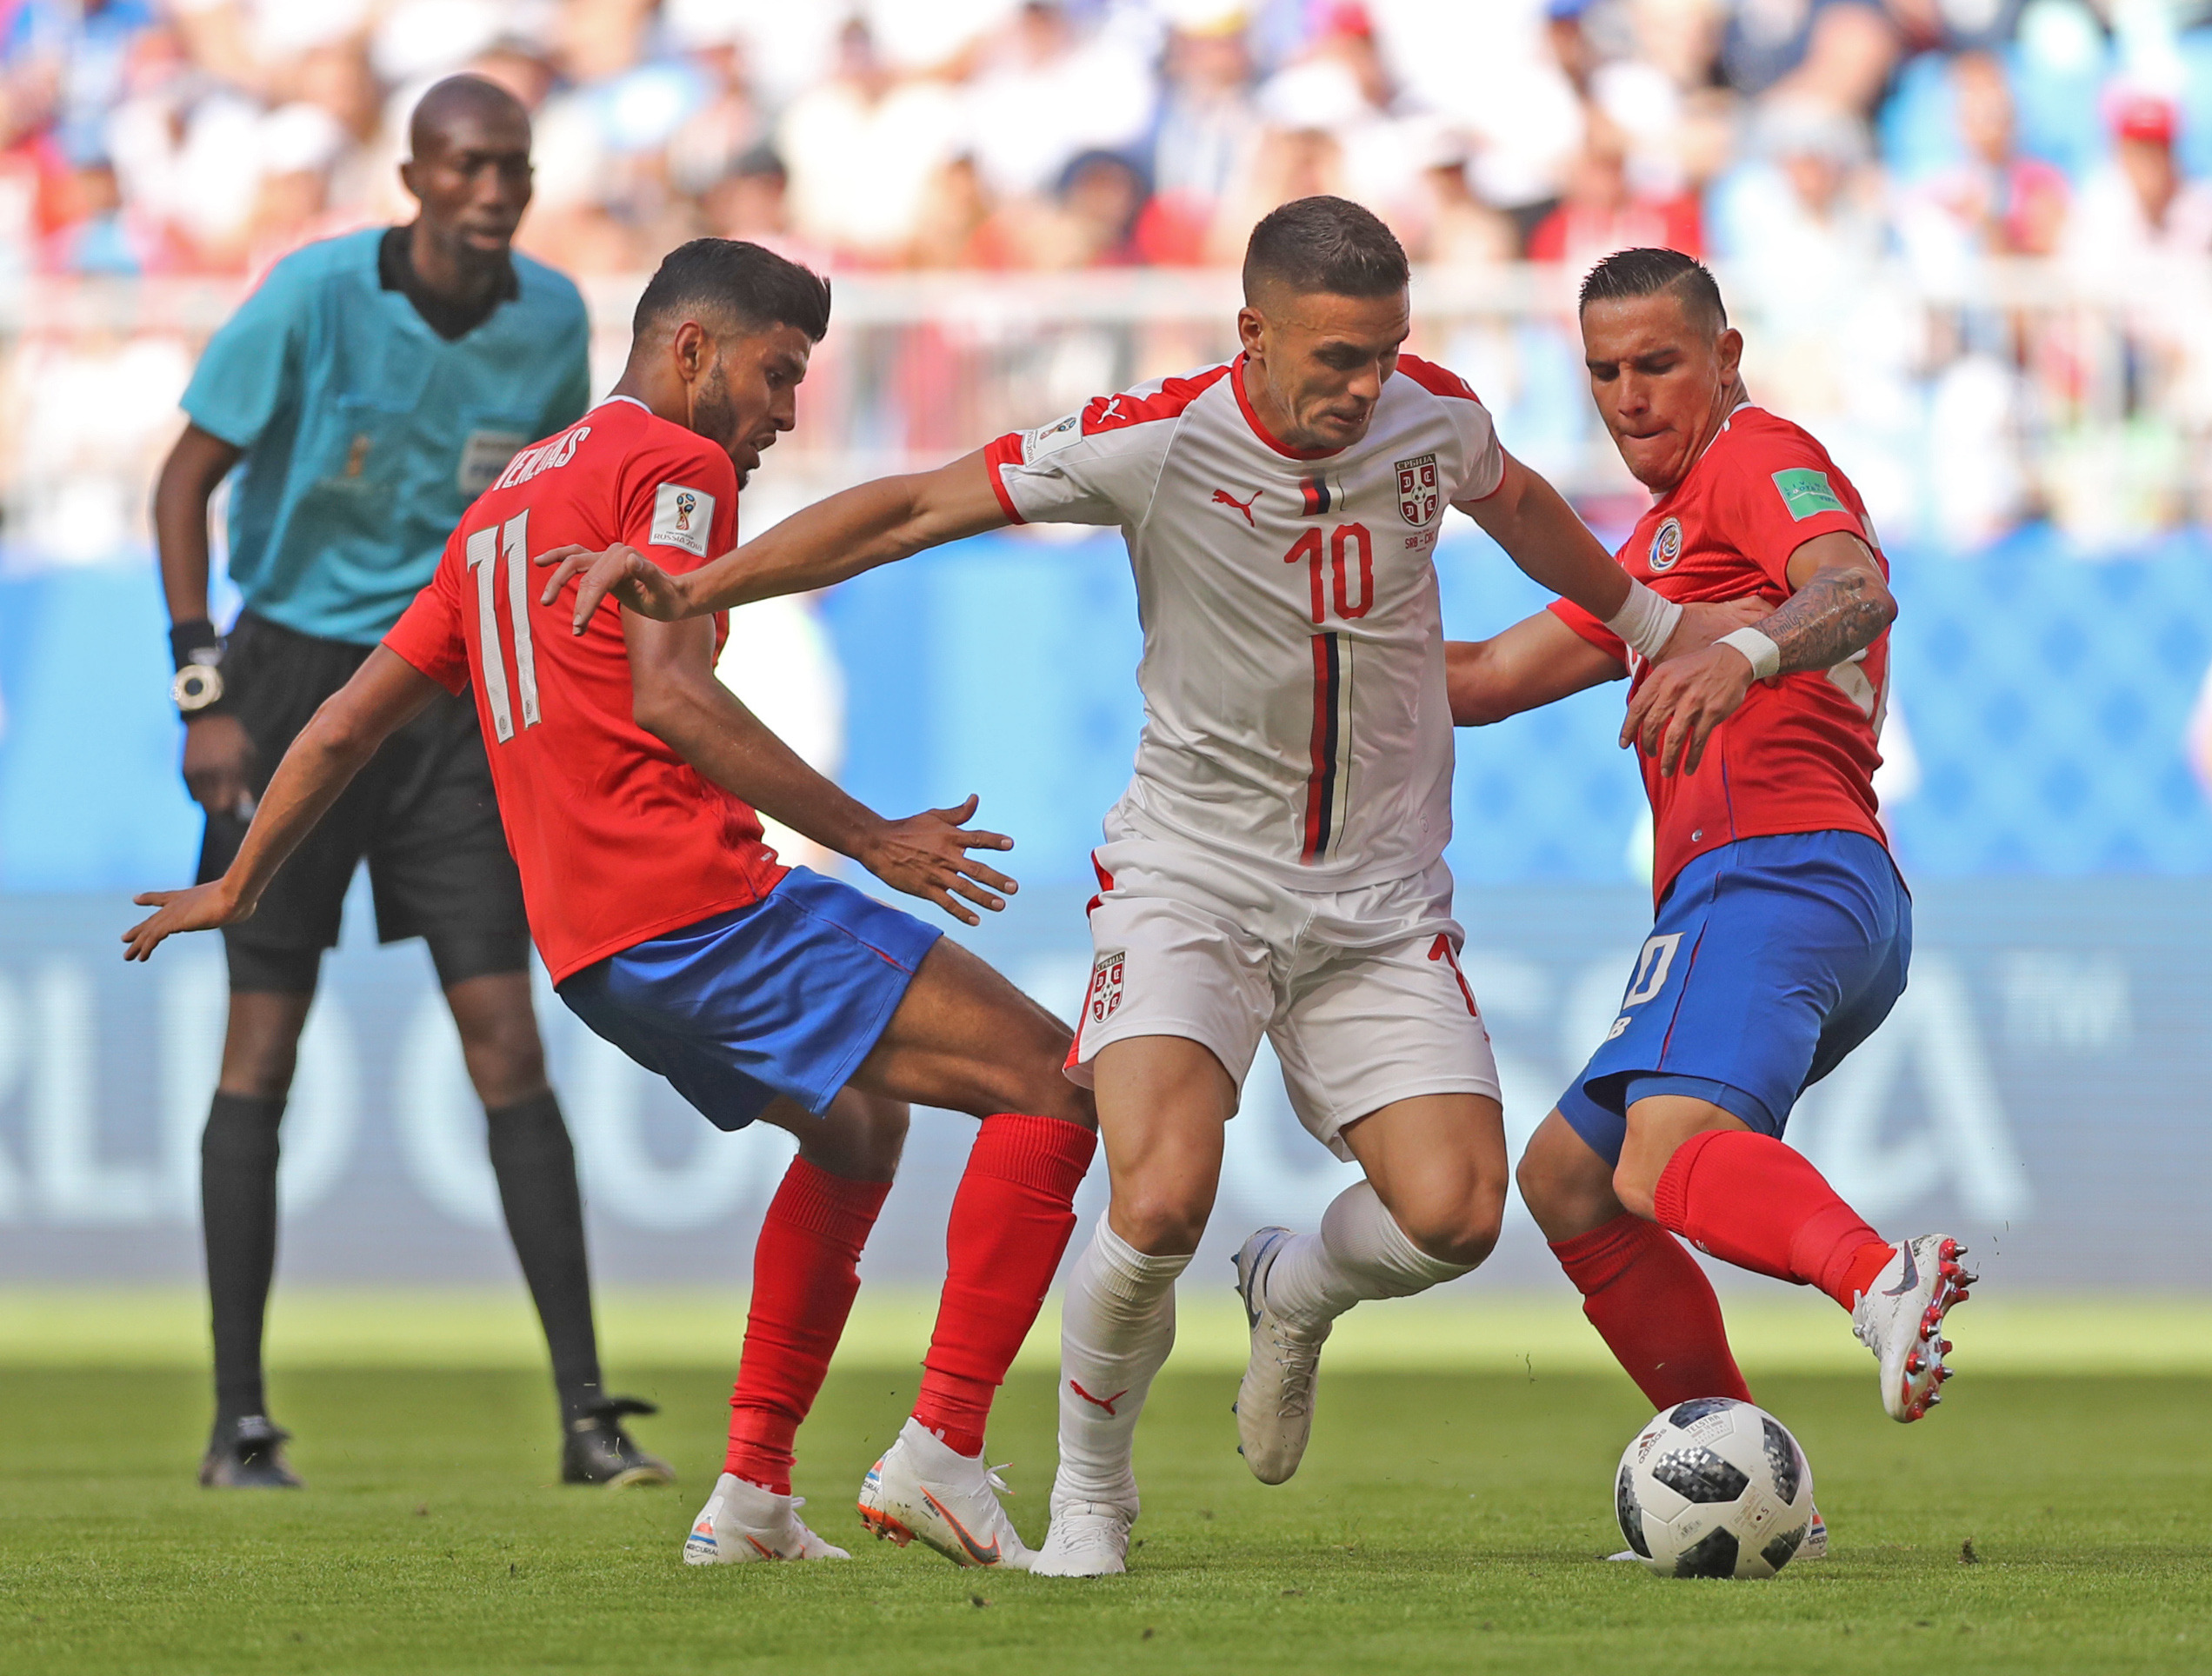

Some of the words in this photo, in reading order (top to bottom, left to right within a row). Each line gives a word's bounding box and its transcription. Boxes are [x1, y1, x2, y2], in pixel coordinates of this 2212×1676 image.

[654, 533, 686, 544] RUSSIA
[685, 540, 703, 552] 2018
[1404, 535, 1418, 549] SRB
[1283, 522, 1374, 624] 10
[466, 507, 542, 745] 11
[1686, 1414, 1722, 1434] TELSTAR
[1638, 1428, 1668, 1465] adidas
